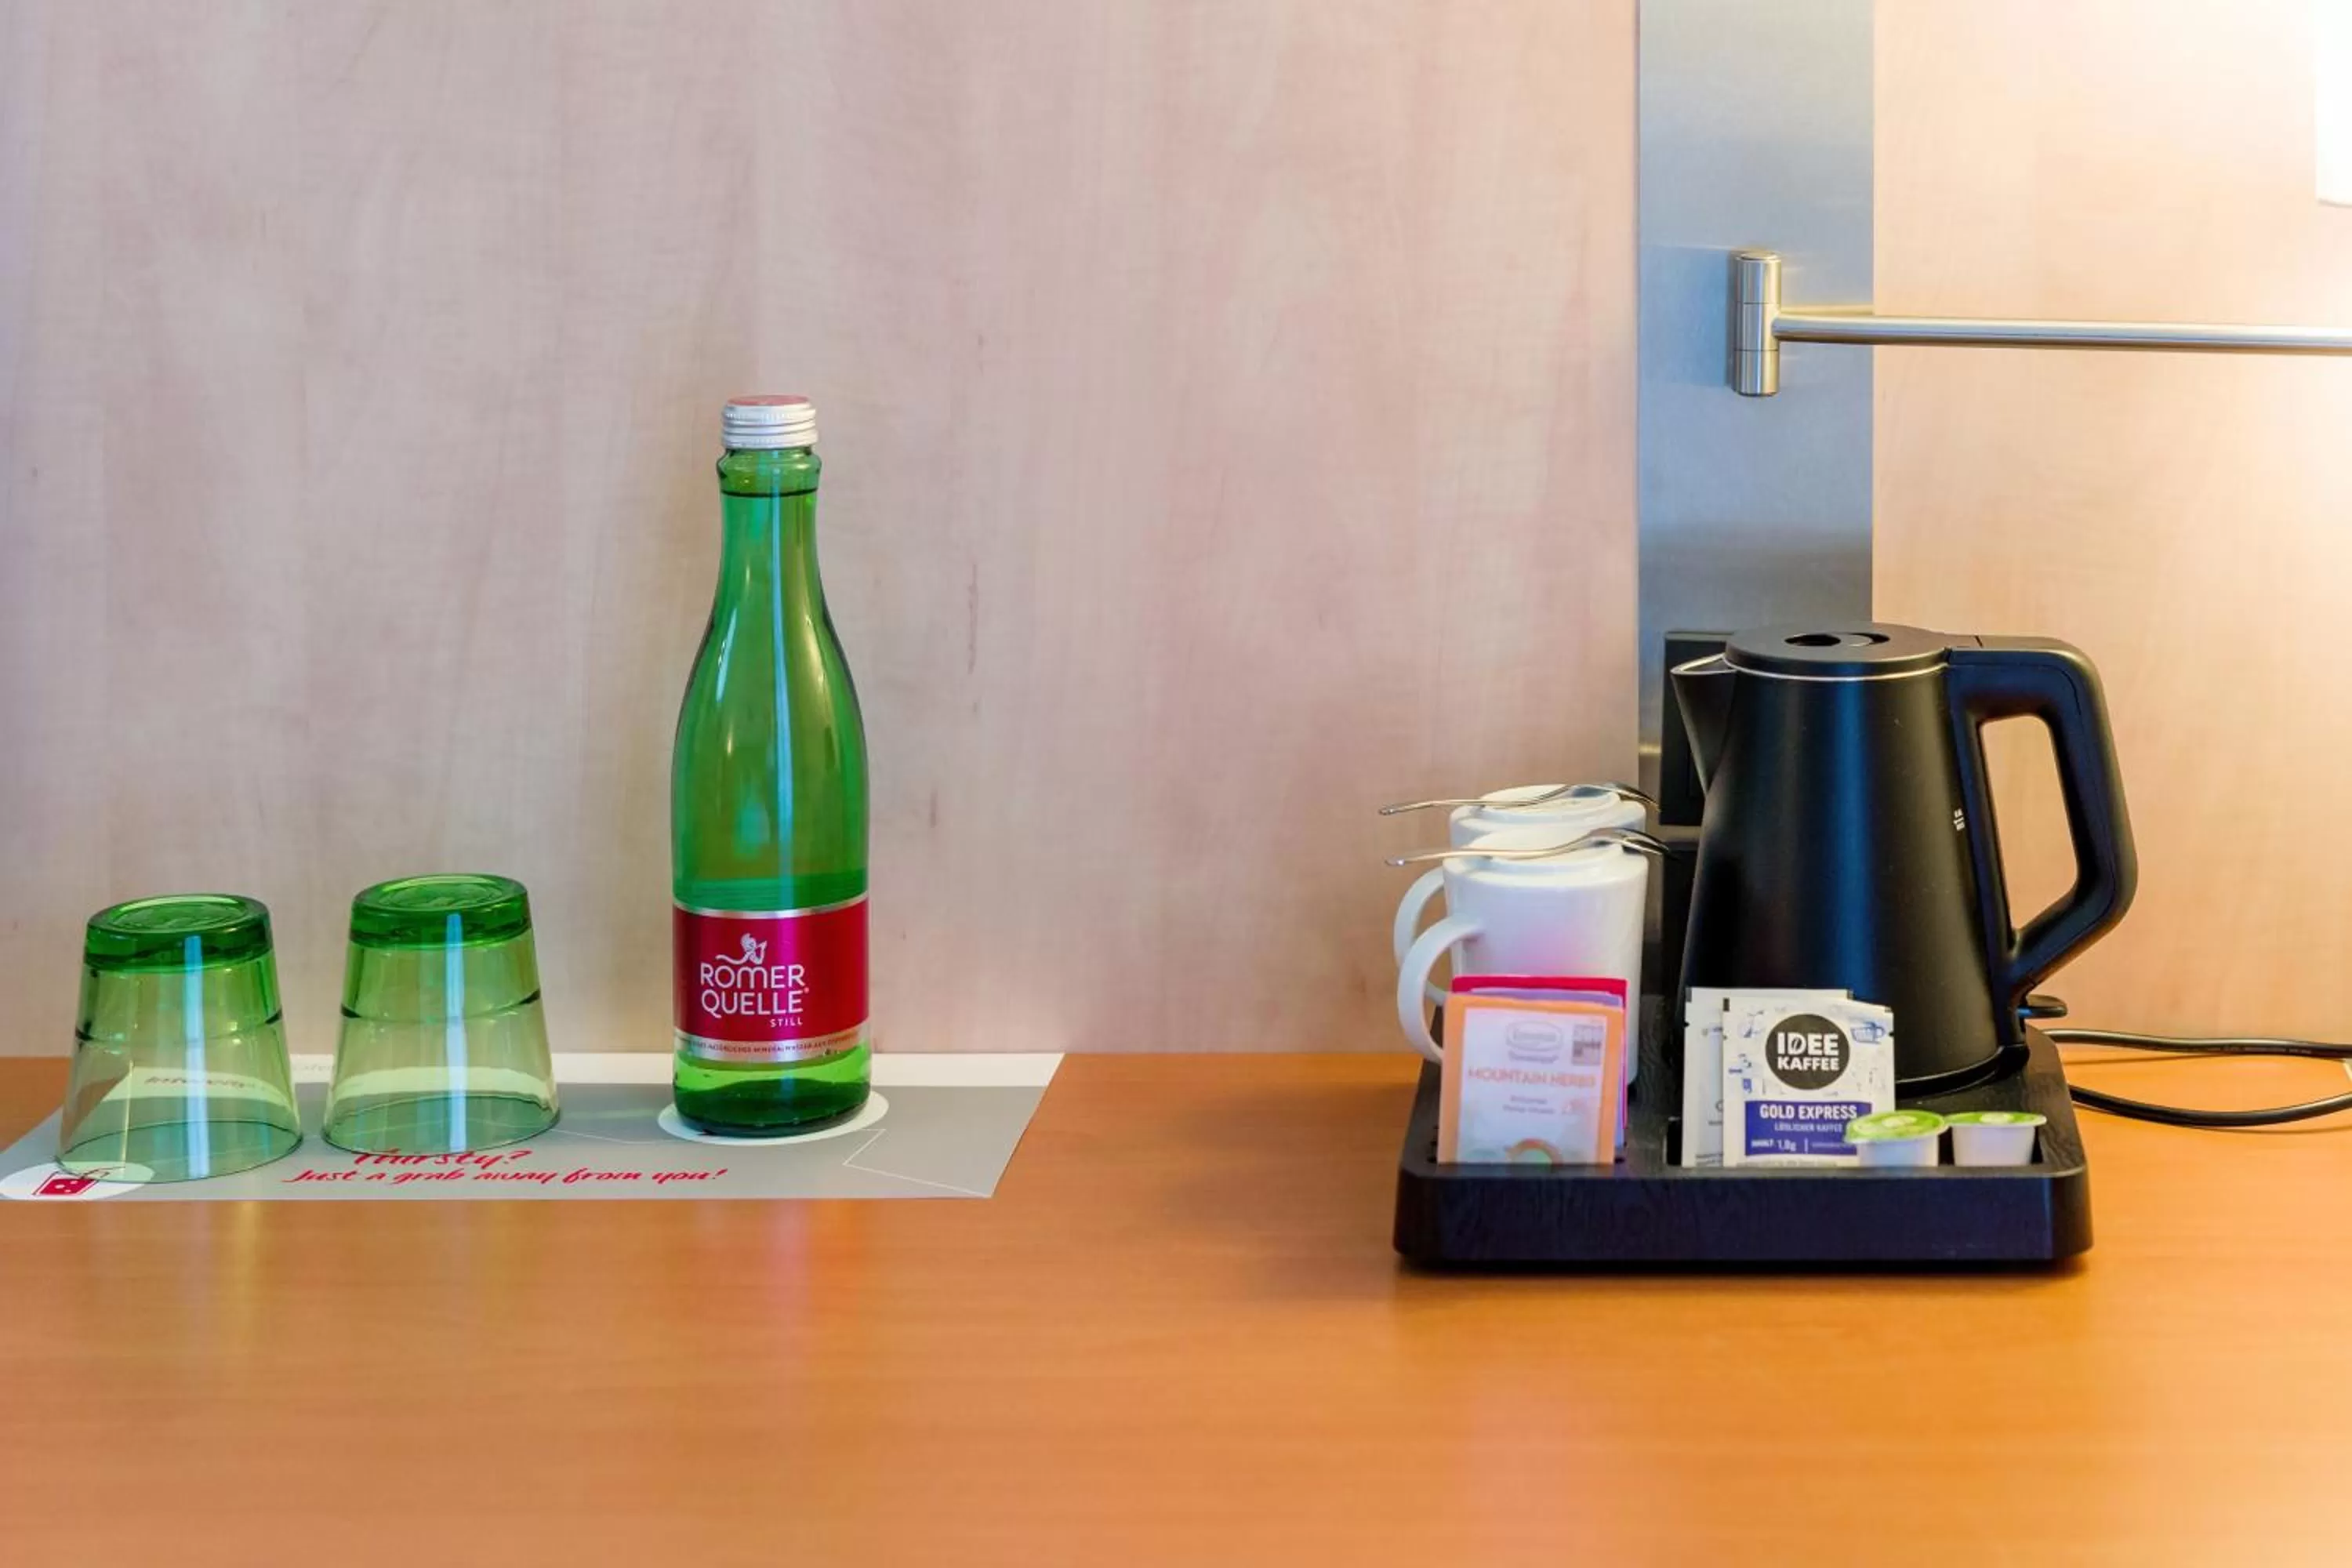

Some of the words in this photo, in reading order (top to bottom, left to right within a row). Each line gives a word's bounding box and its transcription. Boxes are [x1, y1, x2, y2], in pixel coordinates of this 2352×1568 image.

[701, 989, 803, 1018] QUELLE
[770, 1018, 803, 1028] STILL
[1777, 1032, 1839, 1056] IDEE
[1777, 1055, 1840, 1071] KAFFEE
[1760, 1104, 1795, 1119] GOLD
[1798, 1105, 1857, 1120] EXPRESS
[390, 1167, 465, 1185] grab
[473, 1172, 557, 1184] away
[562, 1167, 642, 1184] from
[652, 1168, 728, 1185] you!
